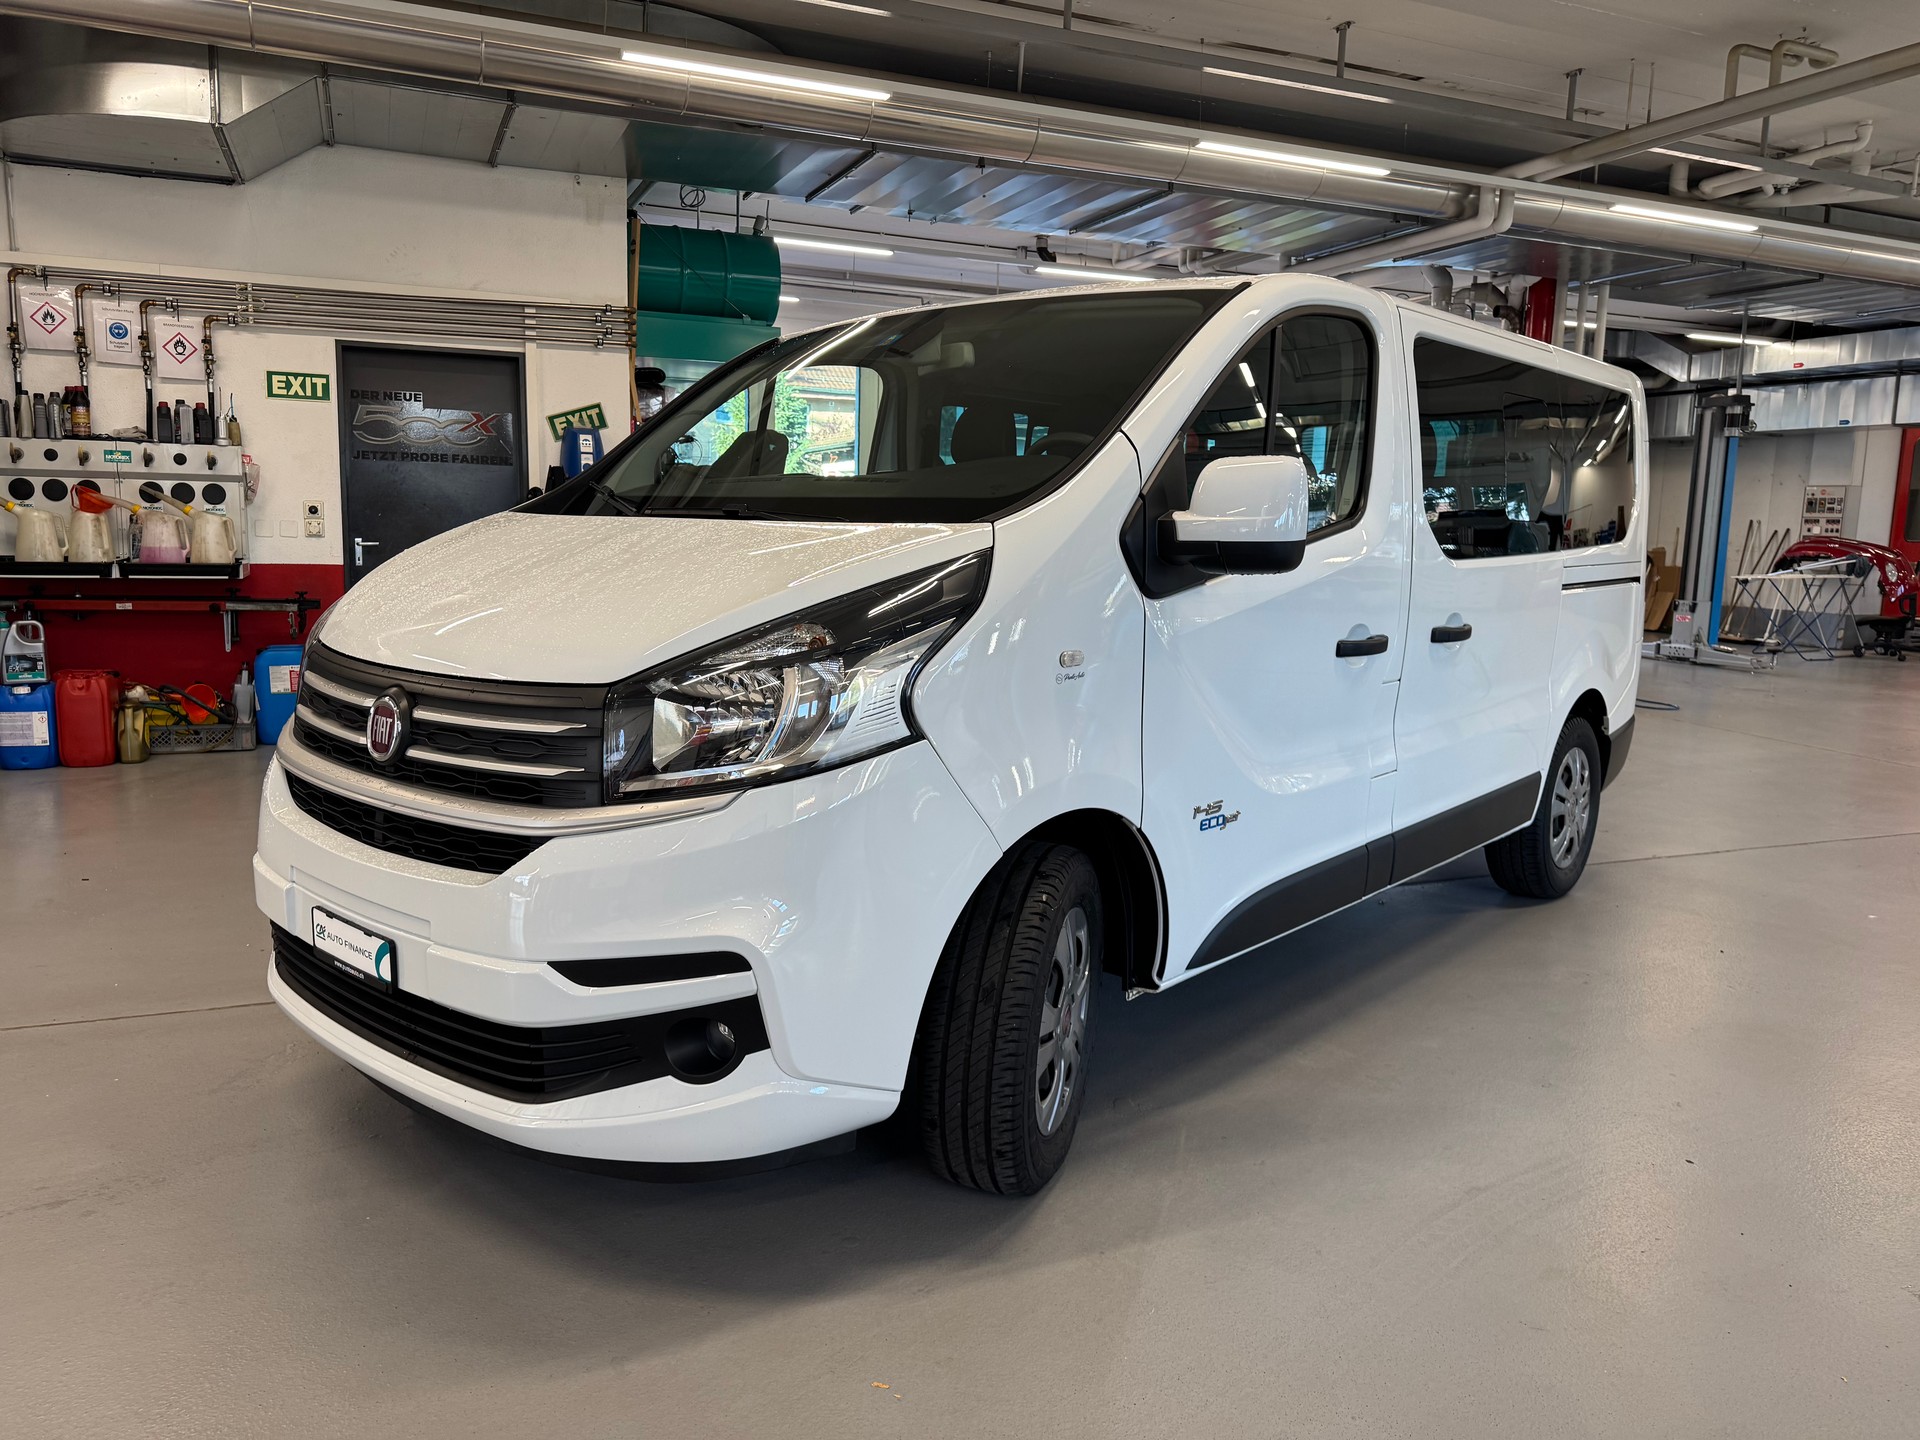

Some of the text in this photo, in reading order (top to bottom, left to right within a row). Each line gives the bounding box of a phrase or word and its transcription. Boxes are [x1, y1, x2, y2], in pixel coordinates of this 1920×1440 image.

[271, 374, 327, 397] EXIT
[350, 389, 422, 402] DER NEUE
[553, 408, 600, 437] EXIT
[353, 450, 398, 461] JETZT
[400, 452, 449, 463] PROBE
[372, 714, 393, 745] FIAT
[327, 932, 343, 946] AUTO
[344, 941, 373, 960] FINANCE
